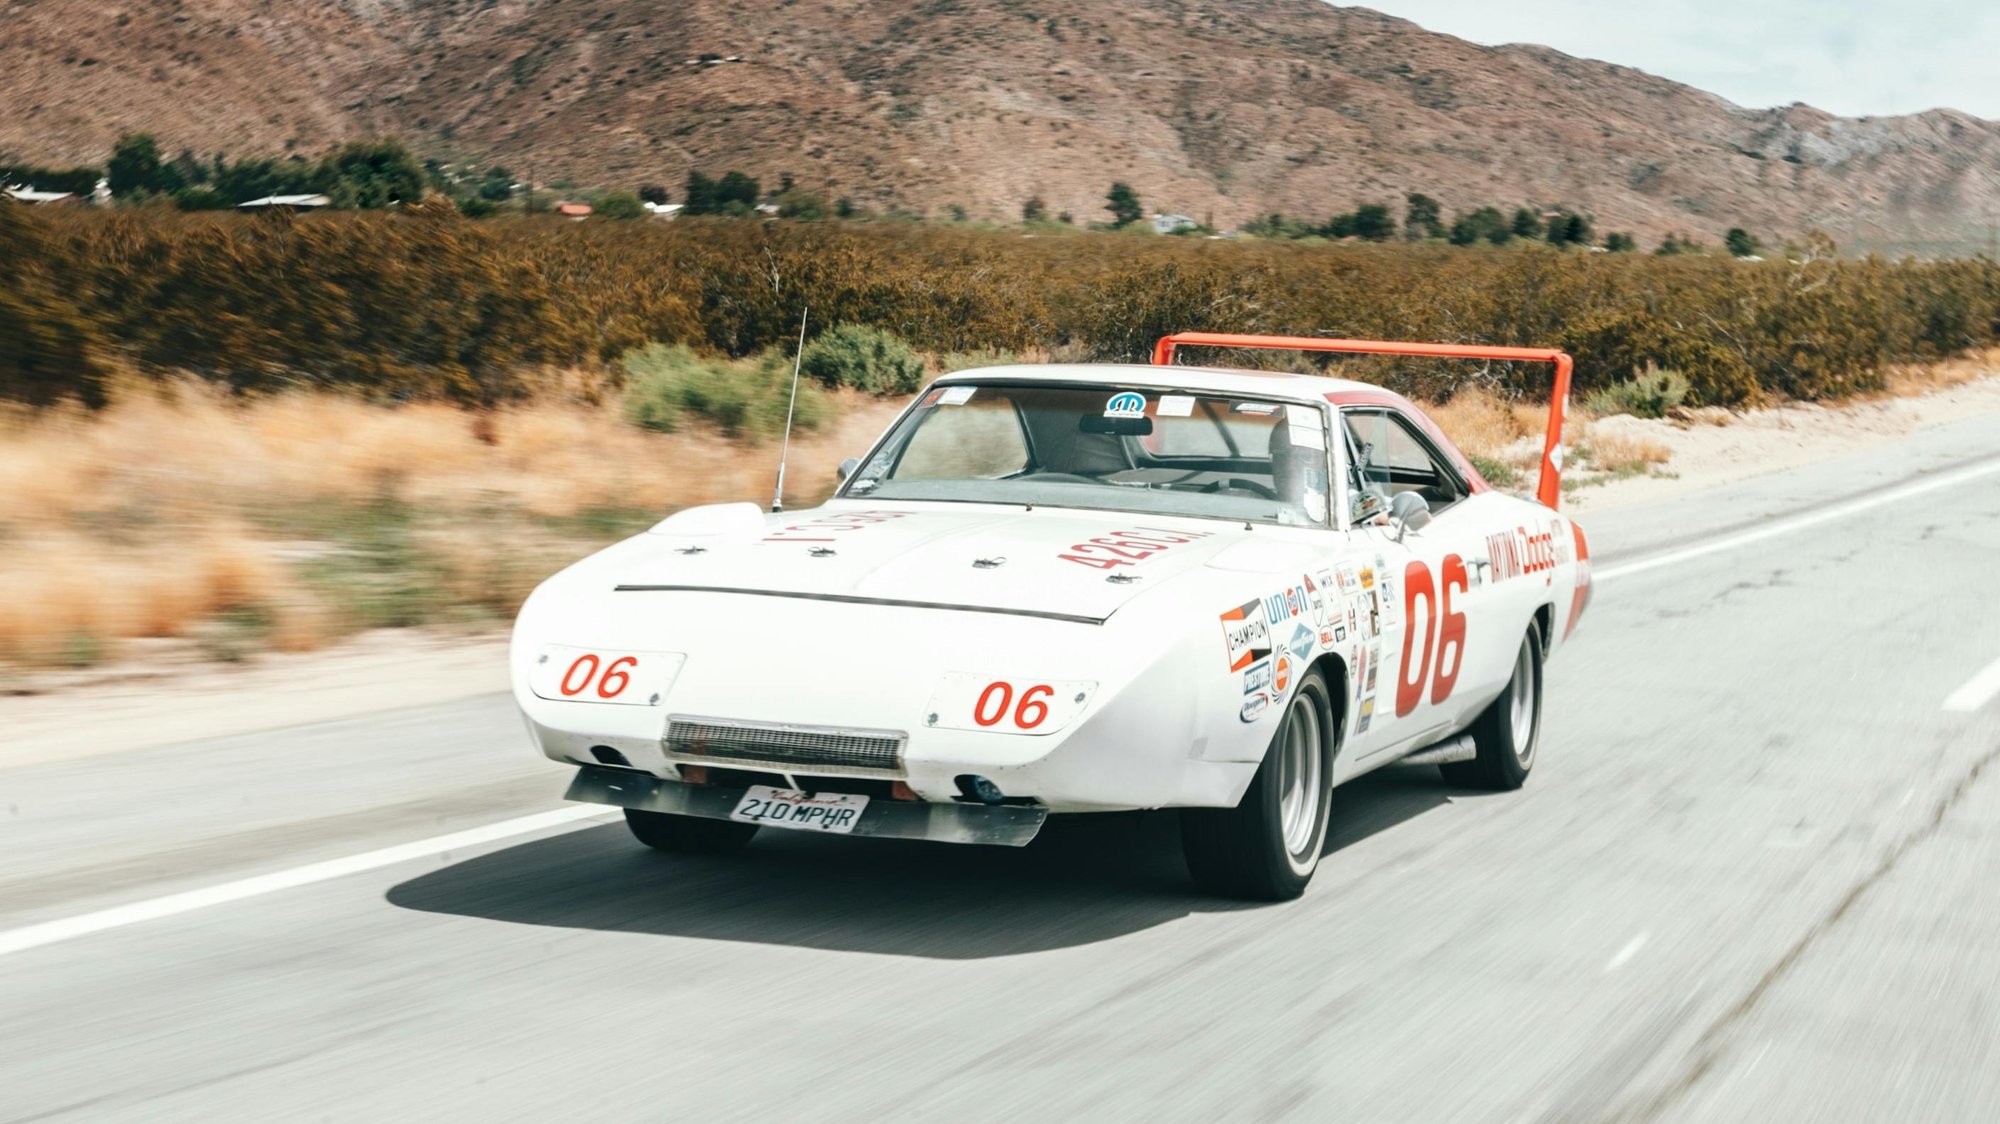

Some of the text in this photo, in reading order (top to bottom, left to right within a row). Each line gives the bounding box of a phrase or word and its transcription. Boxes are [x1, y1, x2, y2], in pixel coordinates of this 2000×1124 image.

[1228, 619, 1267, 652] CHAMPION
[1320, 630, 1334, 645] BELL
[1395, 553, 1469, 719] 06
[559, 653, 637, 698] 06
[973, 681, 1054, 729] 06
